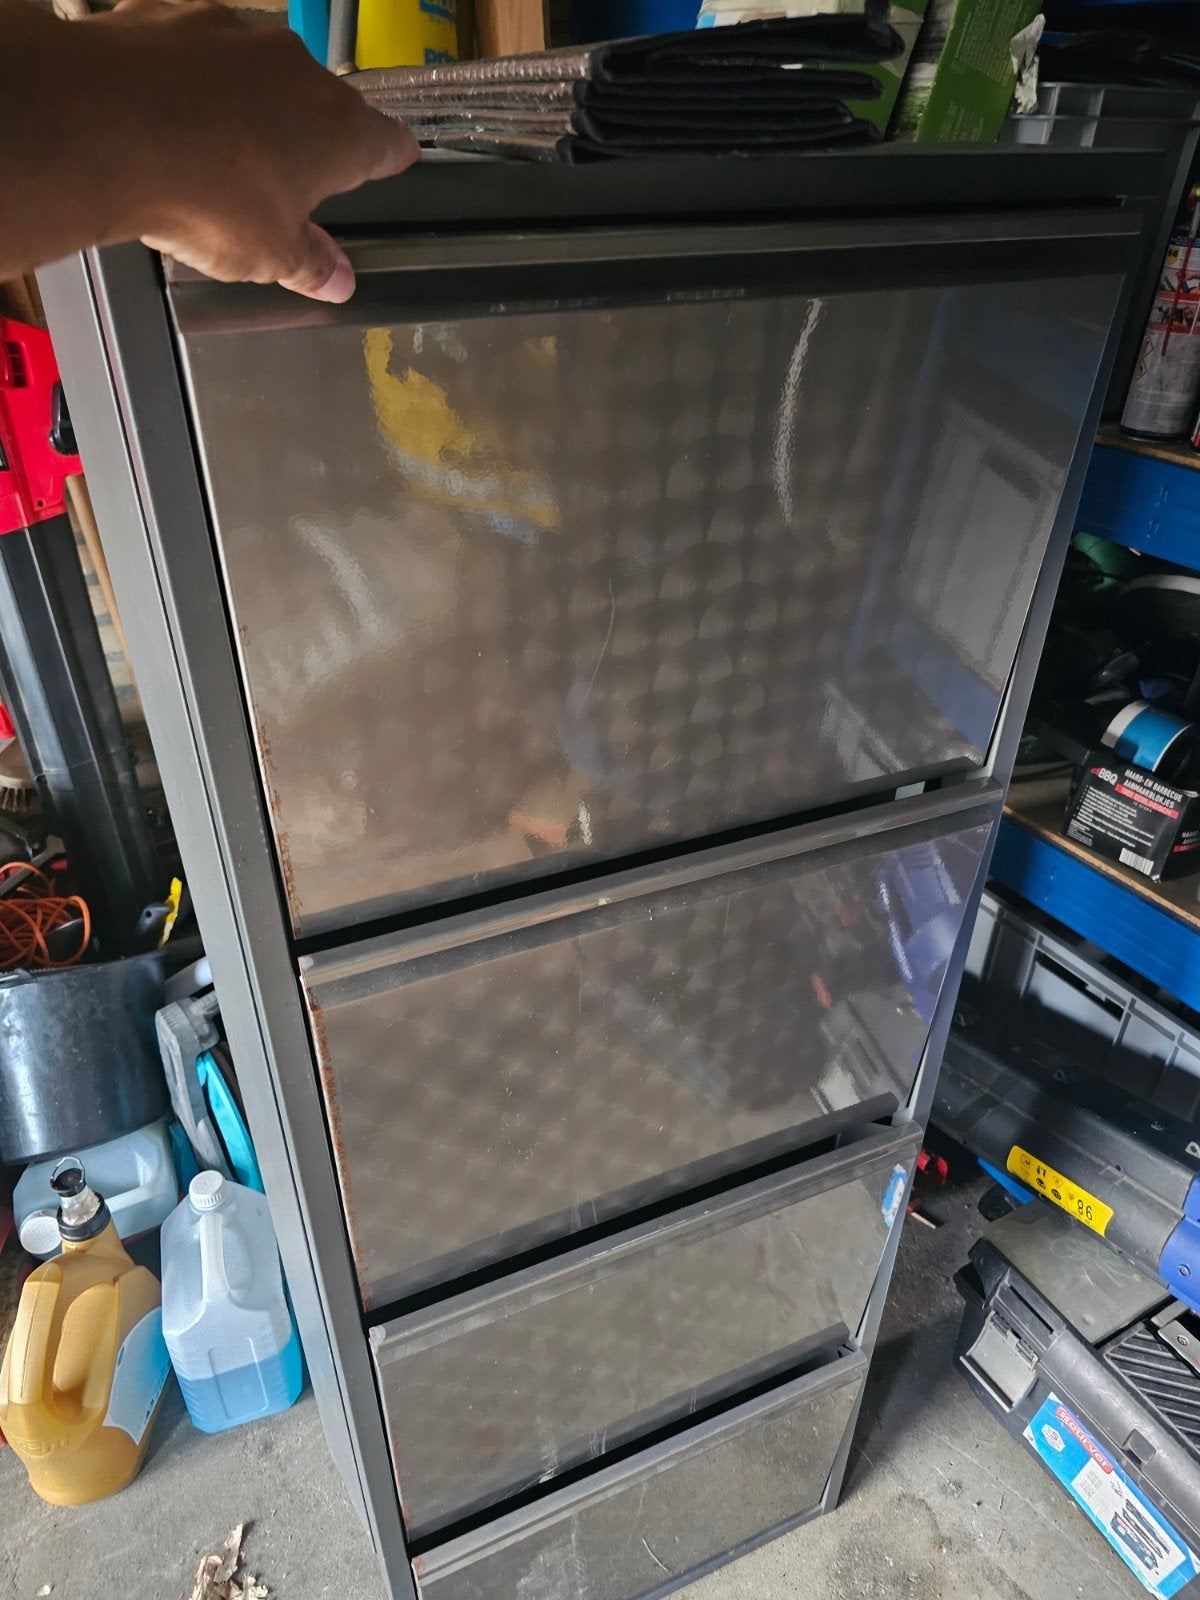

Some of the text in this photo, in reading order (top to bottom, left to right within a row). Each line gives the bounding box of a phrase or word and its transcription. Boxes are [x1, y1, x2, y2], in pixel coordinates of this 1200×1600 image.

[1098, 767, 1118, 786] BBQ
[1144, 778, 1154, 787] EN
[1152, 782, 1183, 802] BARBECUE
